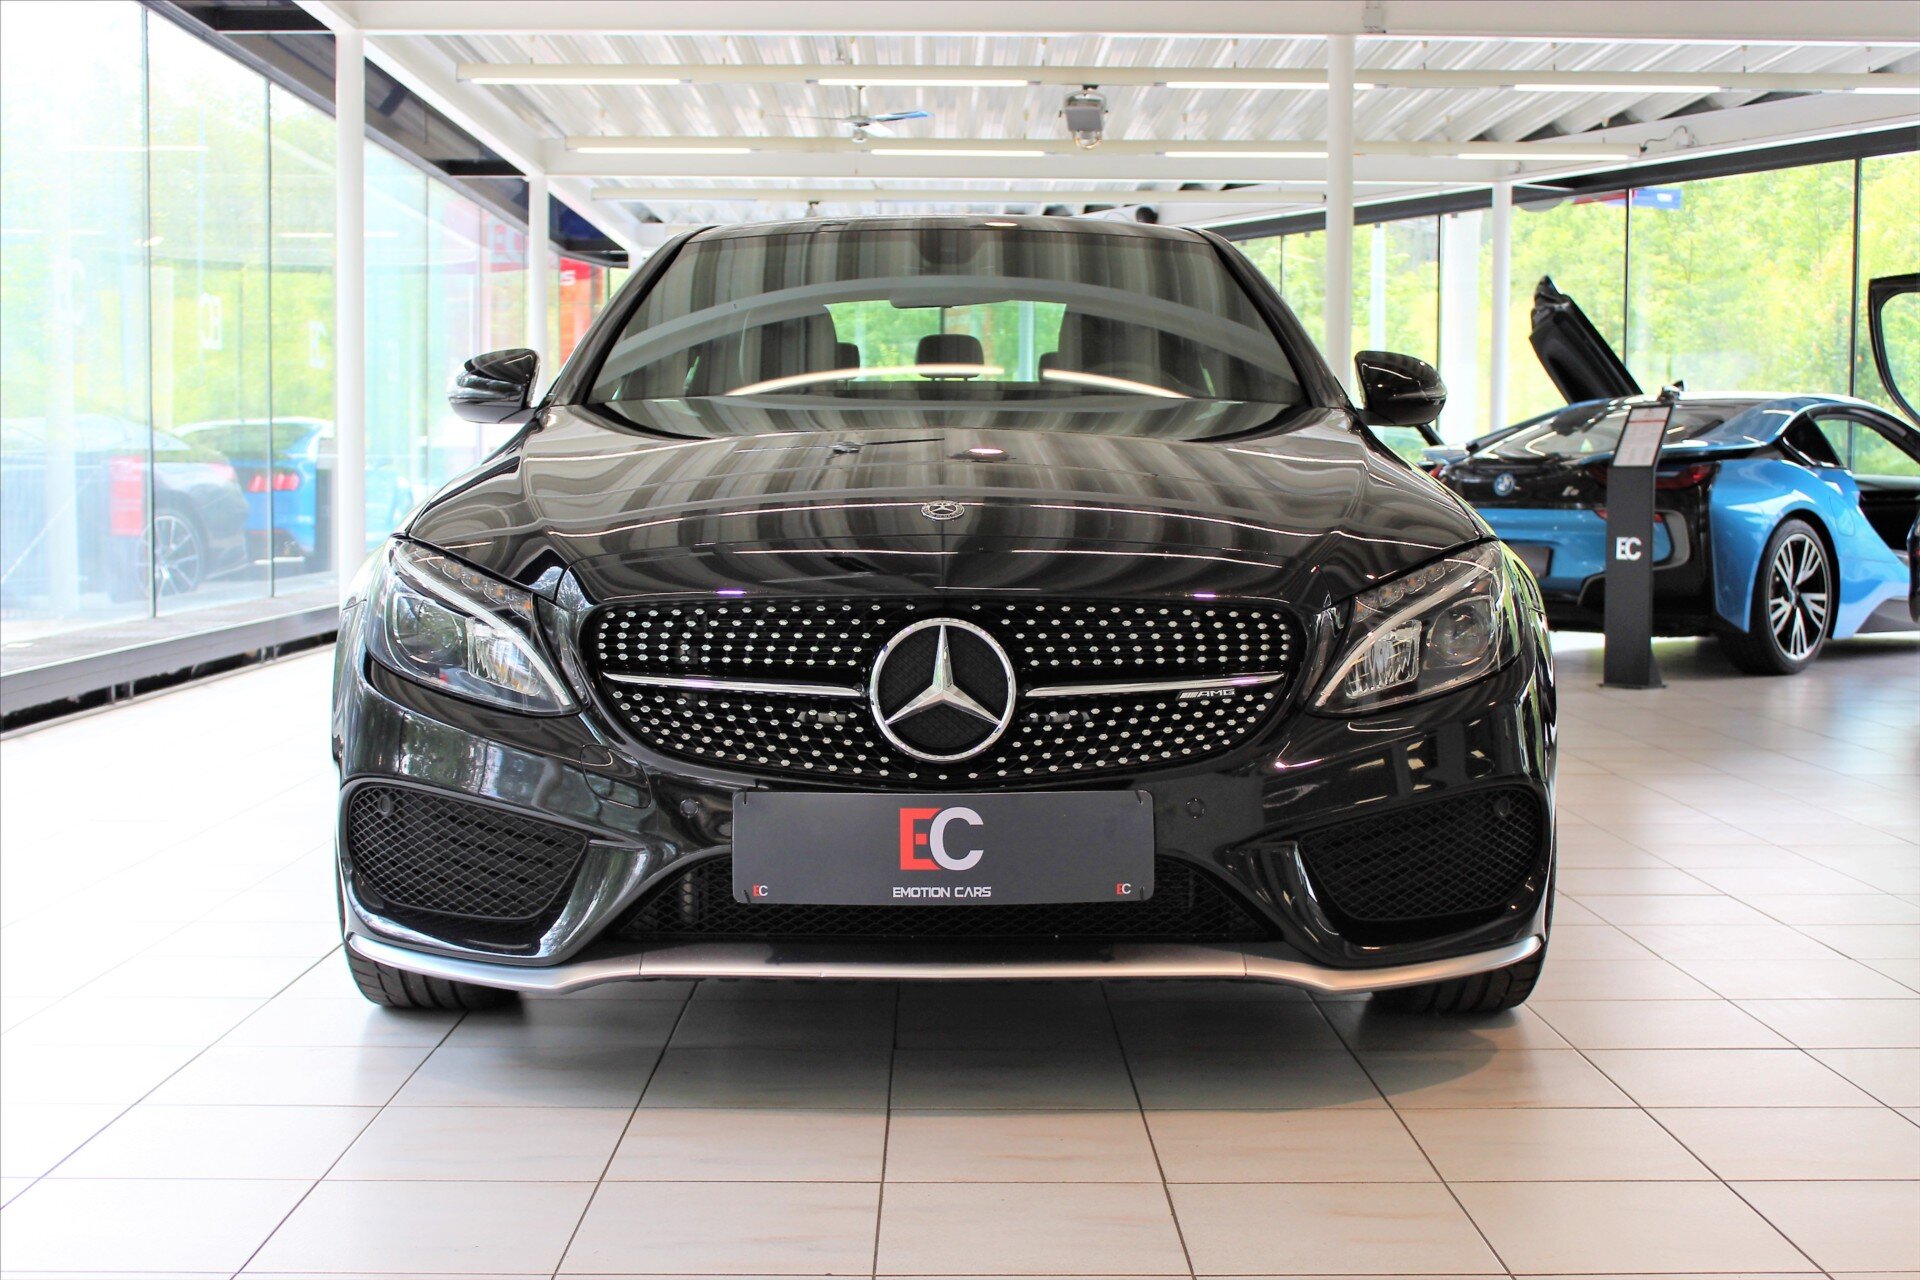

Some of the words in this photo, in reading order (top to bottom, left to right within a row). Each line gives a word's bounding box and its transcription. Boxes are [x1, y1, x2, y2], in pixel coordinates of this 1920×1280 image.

[1615, 536, 1642, 561] EC
[1197, 688, 1235, 698] AMG
[899, 806, 984, 871] EC
[752, 884, 768, 897] EC
[892, 886, 951, 898] EMOTION
[954, 886, 992, 898] CARS
[1116, 883, 1131, 895] EC
